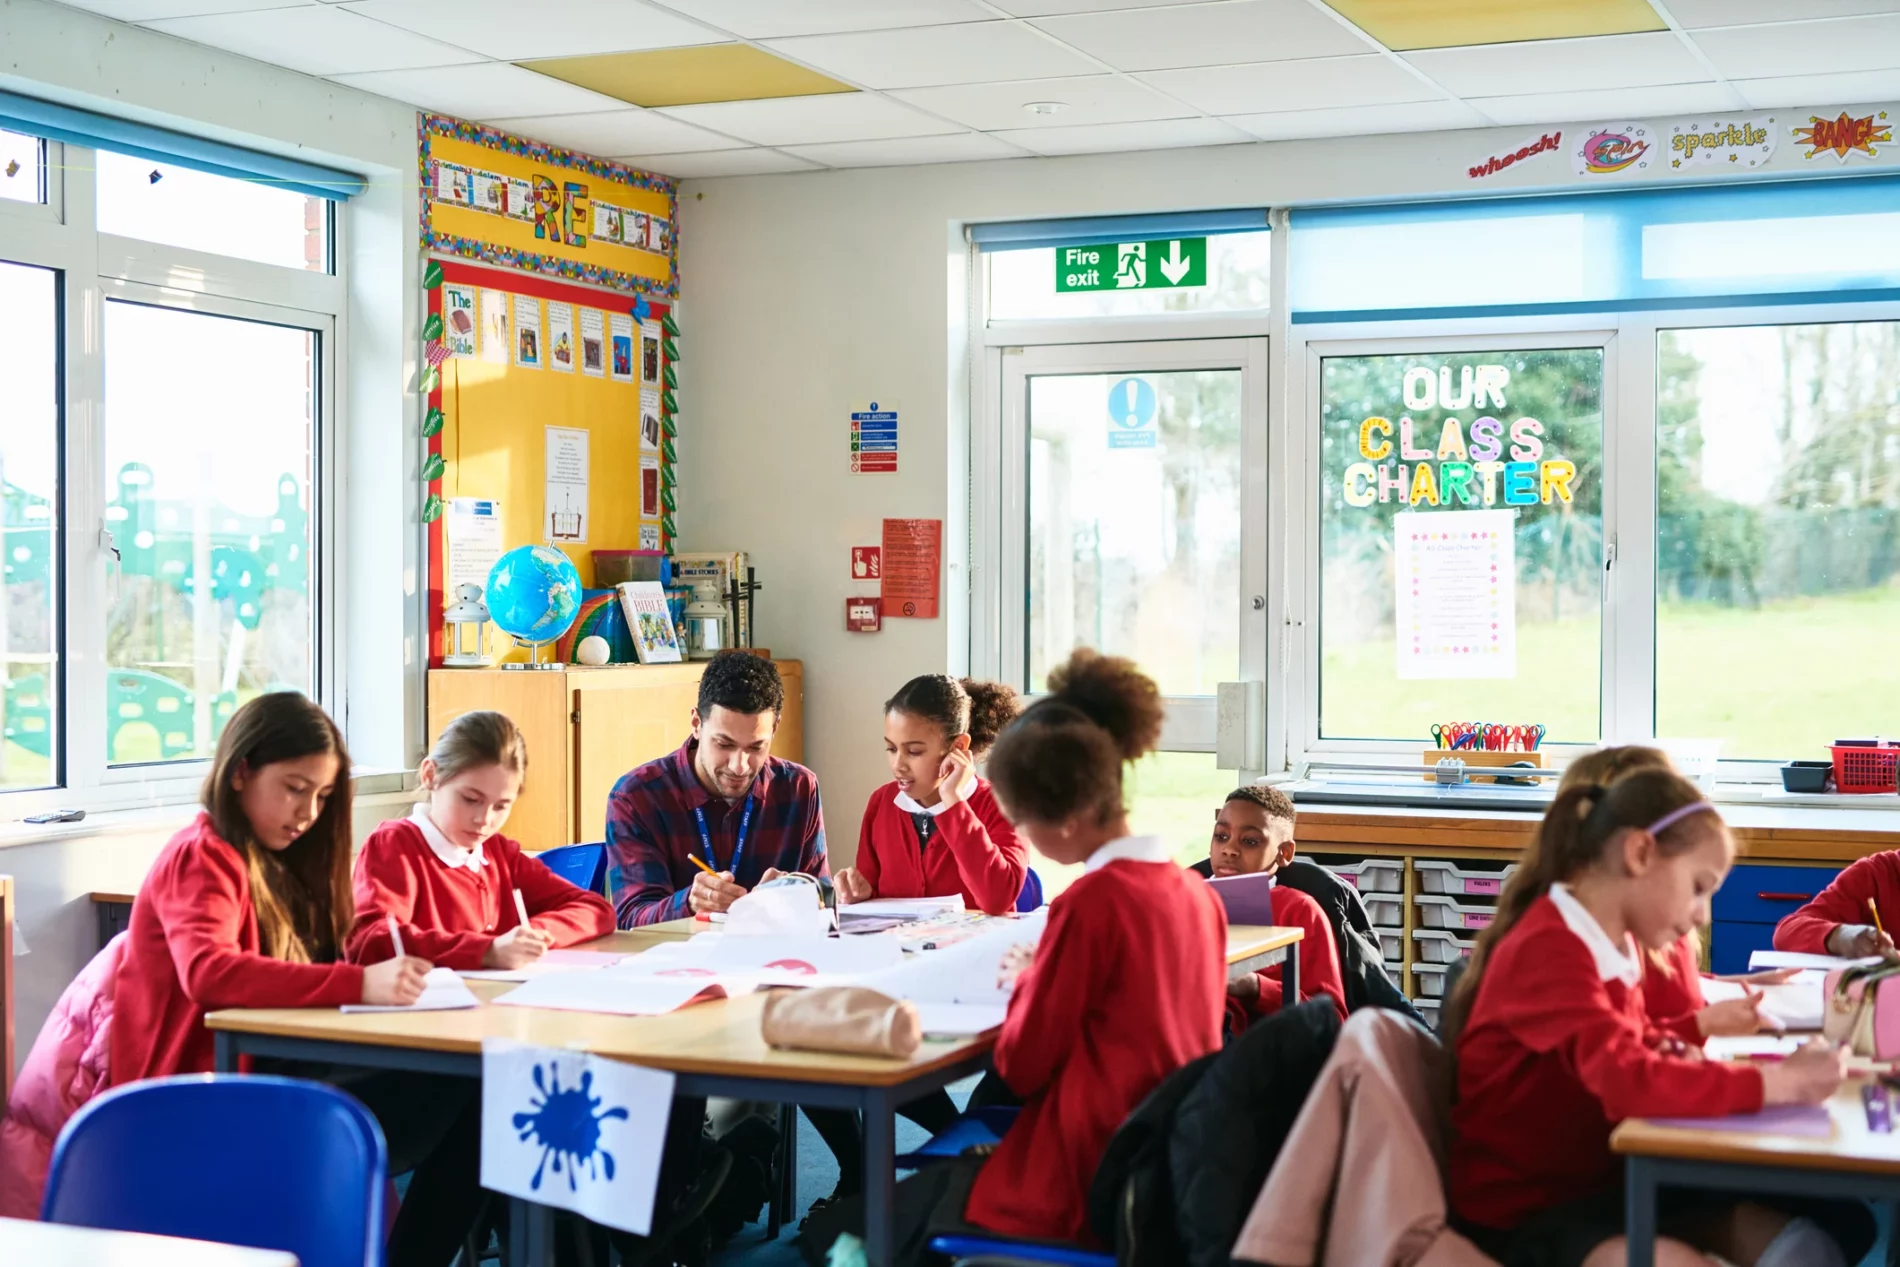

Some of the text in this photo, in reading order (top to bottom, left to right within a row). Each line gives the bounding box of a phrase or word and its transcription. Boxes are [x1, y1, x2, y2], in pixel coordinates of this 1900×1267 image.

[1672, 122, 1767, 158] sparkle
[1813, 117, 1873, 148] BANG!
[1468, 131, 1561, 178] whoosh!
[508, 176, 529, 188] Islam
[532, 174, 589, 248] RE
[1066, 249, 1100, 266] Fire
[1066, 270, 1100, 286] exit
[448, 290, 471, 308] The
[449, 336, 473, 355] Bible
[1403, 365, 1510, 411] OUR
[1359, 416, 1545, 462] CLASS
[1343, 460, 1576, 507] CHARTER
[633, 599, 665, 612] BIBLE
